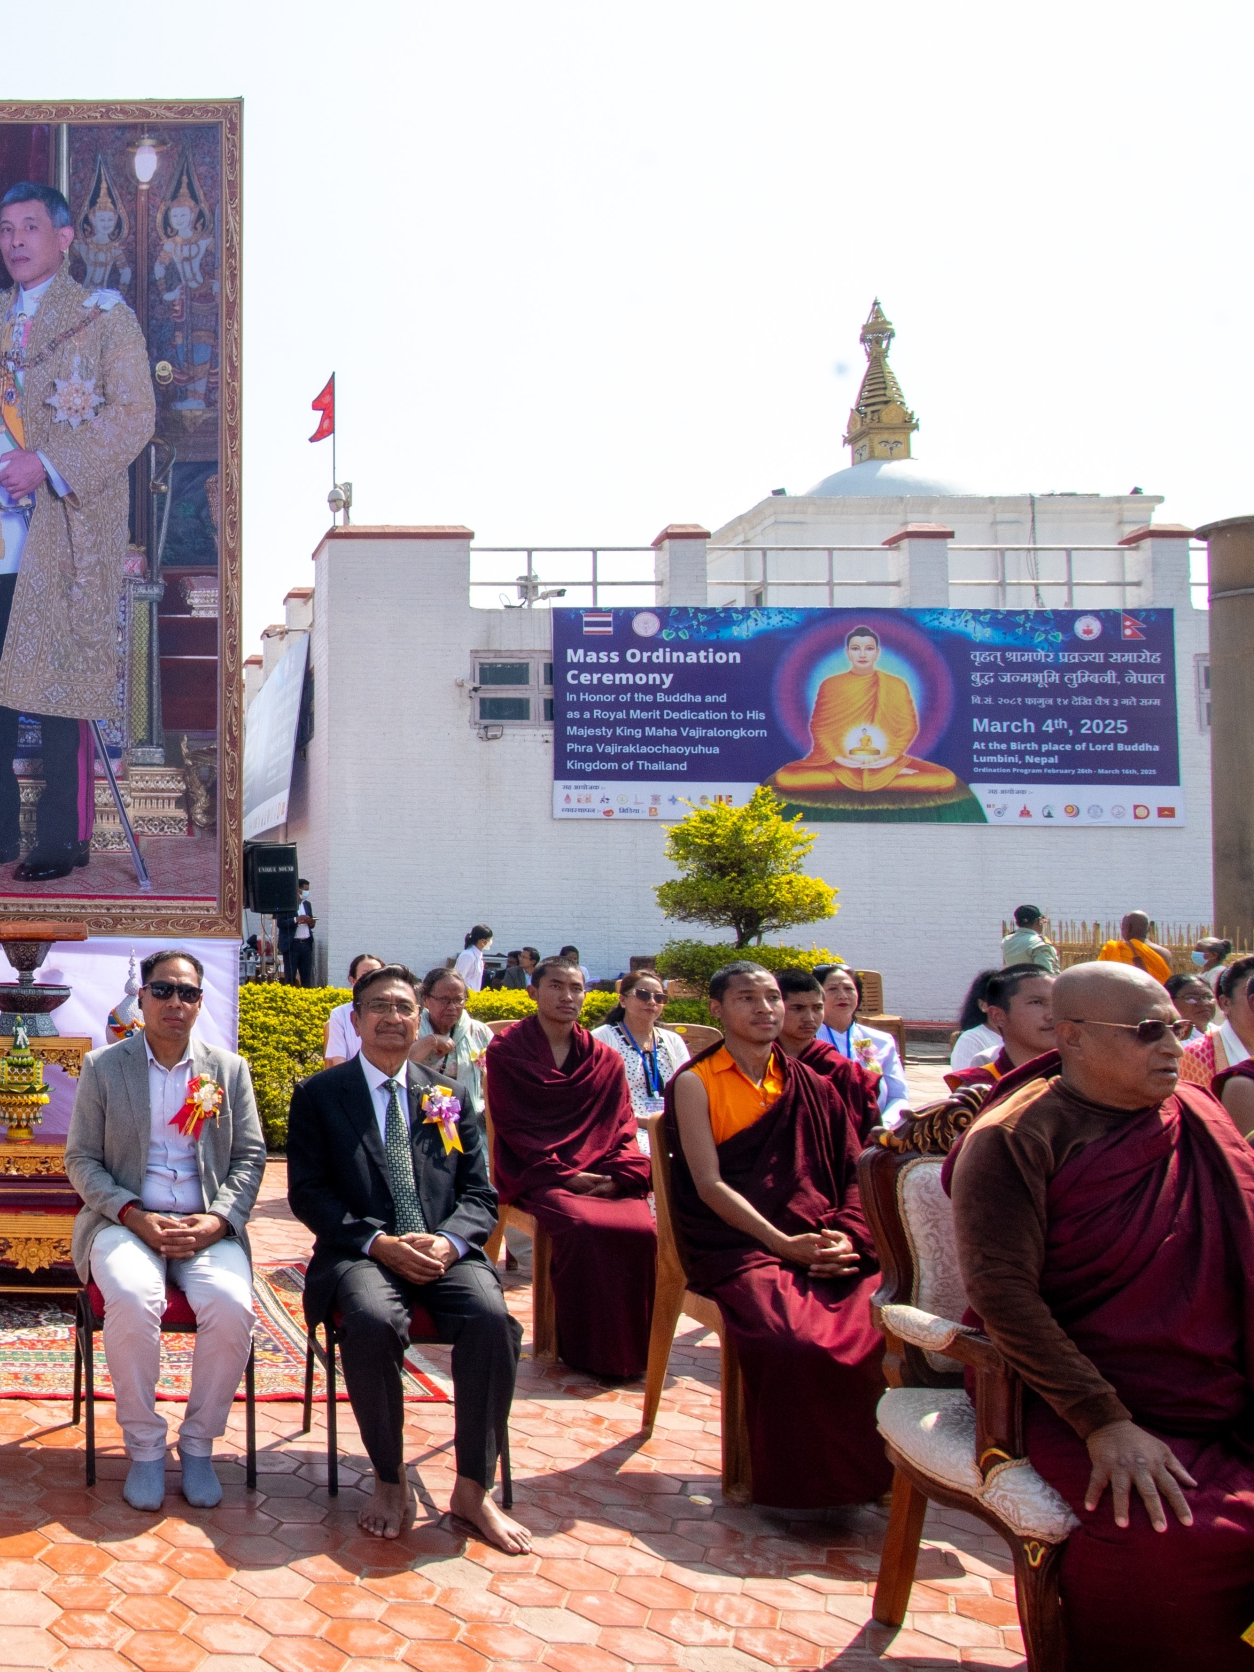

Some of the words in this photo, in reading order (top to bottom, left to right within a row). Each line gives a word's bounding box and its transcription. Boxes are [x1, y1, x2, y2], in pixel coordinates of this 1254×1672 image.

[566, 648, 620, 664] Mass
[625, 647, 741, 664] Ordination
[1108, 649, 1162, 664] समारोह
[566, 669, 674, 689] Ceremony
[970, 671, 995, 687] बुद्ध
[997, 670, 1061, 688] जन्मभूमि
[1124, 670, 1166, 685] नेपाल
[566, 692, 577, 702] In
[579, 692, 617, 702] Honor
[618, 692, 632, 702] of
[633, 692, 654, 703] the
[656, 692, 702, 703] Buddha
[704, 693, 727, 703] and
[566, 710, 581, 719] as
[582, 711, 591, 719] a
[593, 709, 627, 721] Royal
[629, 710, 661, 720] Merit
[663, 710, 728, 720] Dedication
[730, 710, 744, 720] to
[746, 710, 766, 720] His
[566, 726, 614, 739] Majesty
[616, 727, 642, 739] King
[645, 727, 678, 737] Maha
[680, 727, 768, 740] Vajiralongkorn
[972, 717, 1036, 733] March
[1041, 717, 1074, 737] 4th,
[1080, 718, 1129, 734] 2025
[566, 743, 594, 753] Phra
[595, 743, 720, 756] Vajiraklaochaoyuhua
[972, 741, 986, 750] At
[987, 741, 1008, 750] the
[1009, 742, 1039, 751] Birth
[1041, 742, 1072, 753] place
[1074, 742, 1087, 751] of
[1088, 743, 1115, 751] Lord
[1116, 743, 1160, 752] Buddha
[566, 759, 619, 772] Kingdom
[621, 760, 634, 771] of
[636, 760, 688, 771] Thailand
[973, 754, 1022, 765] Lumbini,
[1025, 755, 1059, 766] Nepal
[973, 766, 1012, 774] Ordination
[1012, 767, 1043, 775] Program
[1043, 767, 1076, 775] February
